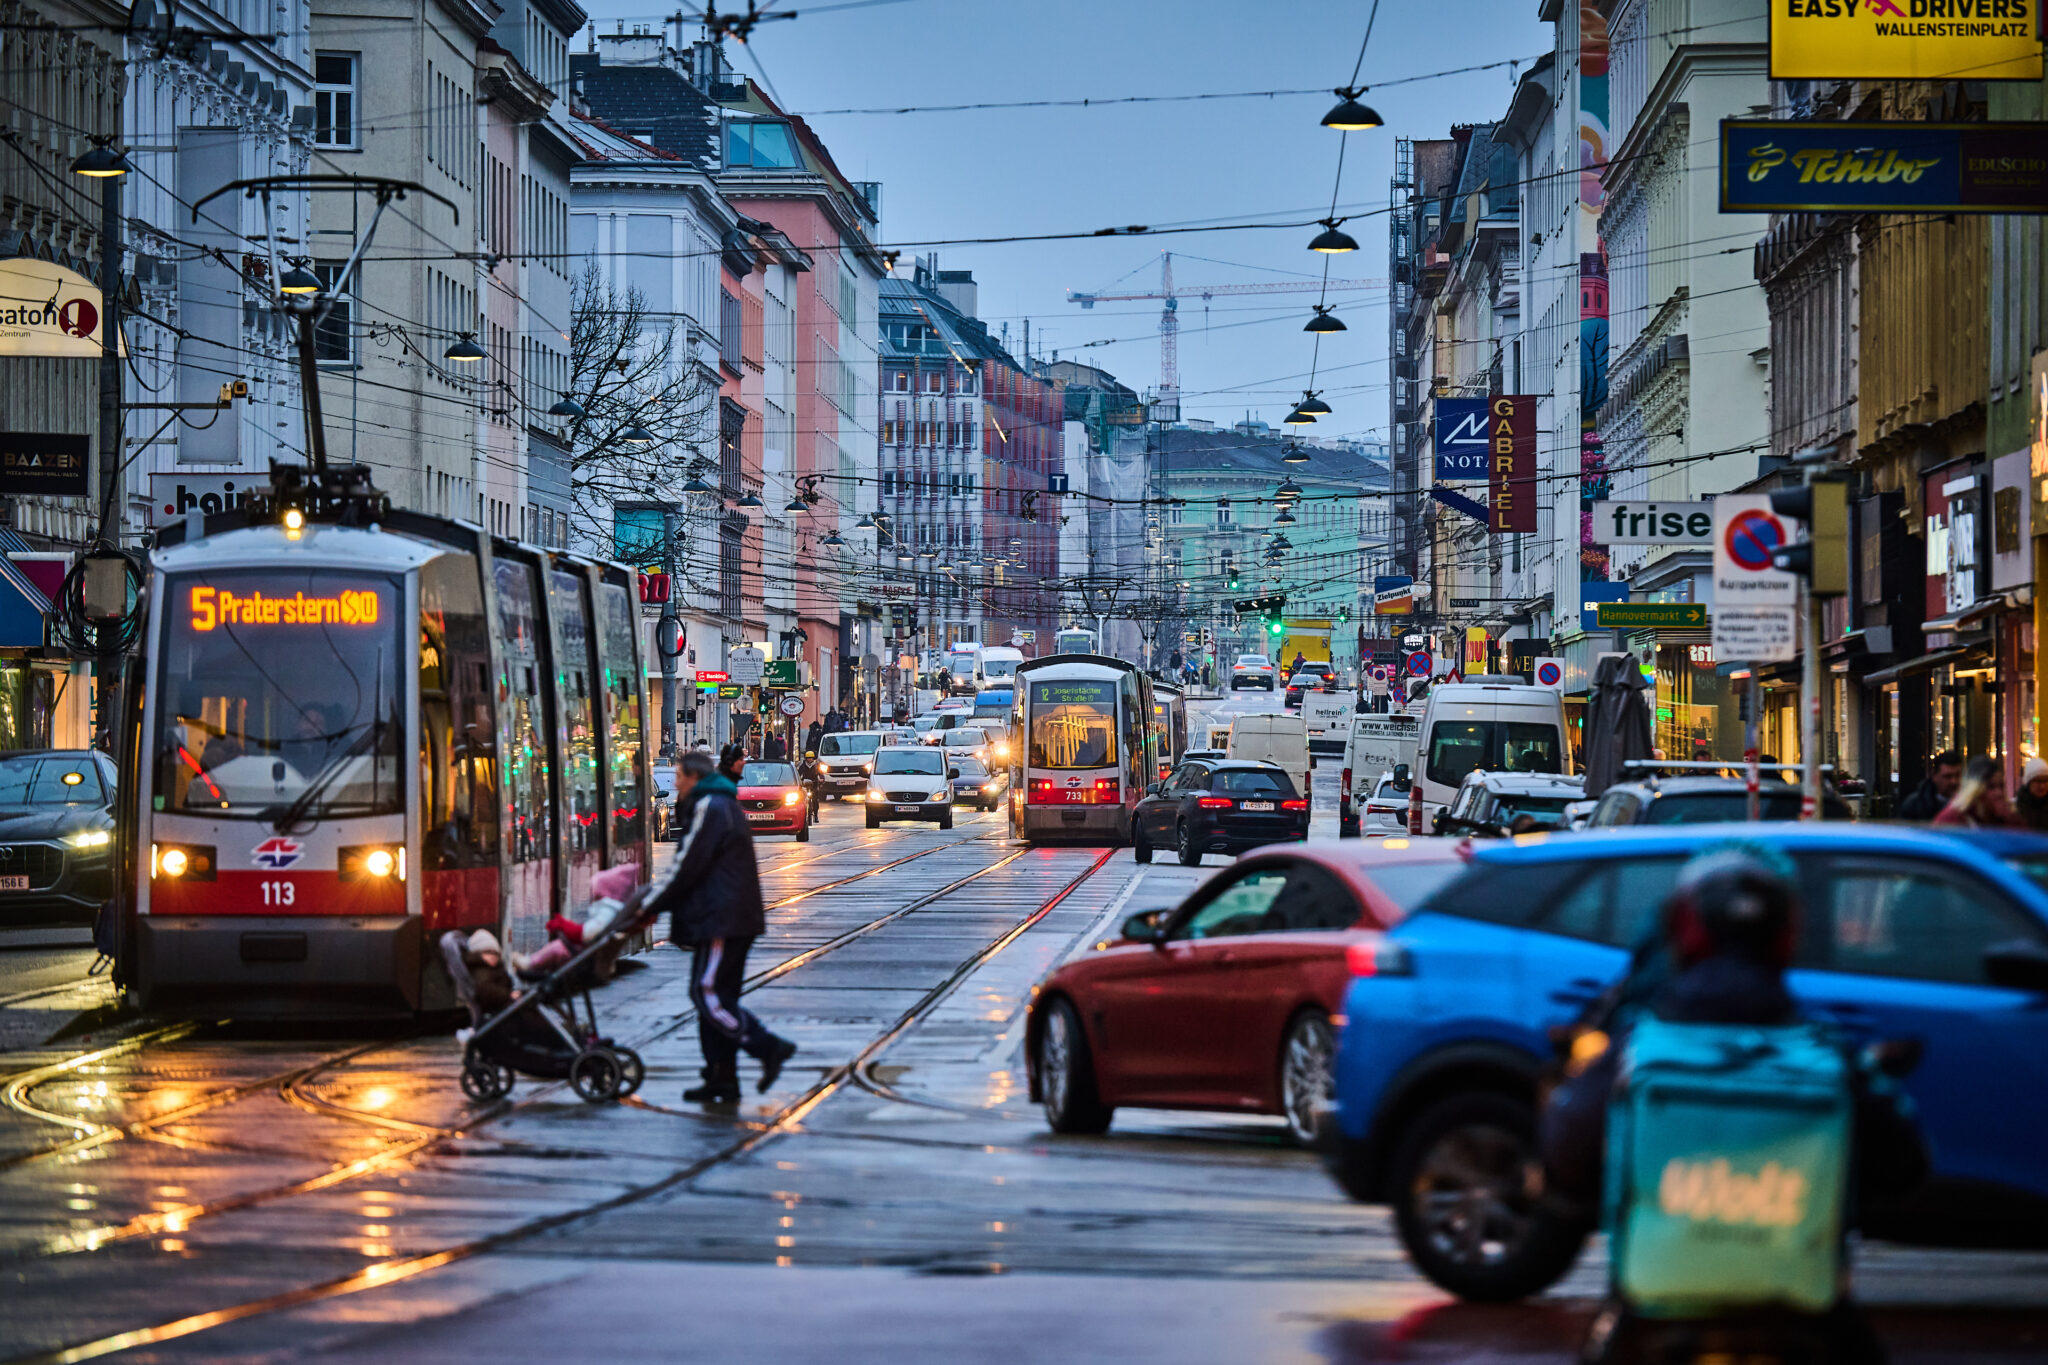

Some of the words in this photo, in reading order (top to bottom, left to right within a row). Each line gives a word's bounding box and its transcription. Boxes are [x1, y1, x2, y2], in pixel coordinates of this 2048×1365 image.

[1788, 0, 1860, 18] EASY
[1910, 0, 2027, 18] DRIVERS
[1875, 23, 2028, 37] WALLENSTEINPLATZ
[1791, 149, 1941, 184] Tchibo
[1967, 157, 2047, 172] EDUSCHO
[4, 452, 82, 469] BAAZEN
[1444, 455, 1490, 469] NOT
[1493, 399, 1515, 529] GABRIEL
[1612, 504, 1712, 538] frise
[1376, 587, 1412, 601] Zielpunkt
[191, 587, 216, 631] 5
[219, 591, 340, 624] Praterstern
[1602, 610, 1680, 622] Hannovermarkt
[1041, 687, 1050, 702] 12
[1066, 791, 1082, 801] 733
[261, 881, 295, 906] 113
